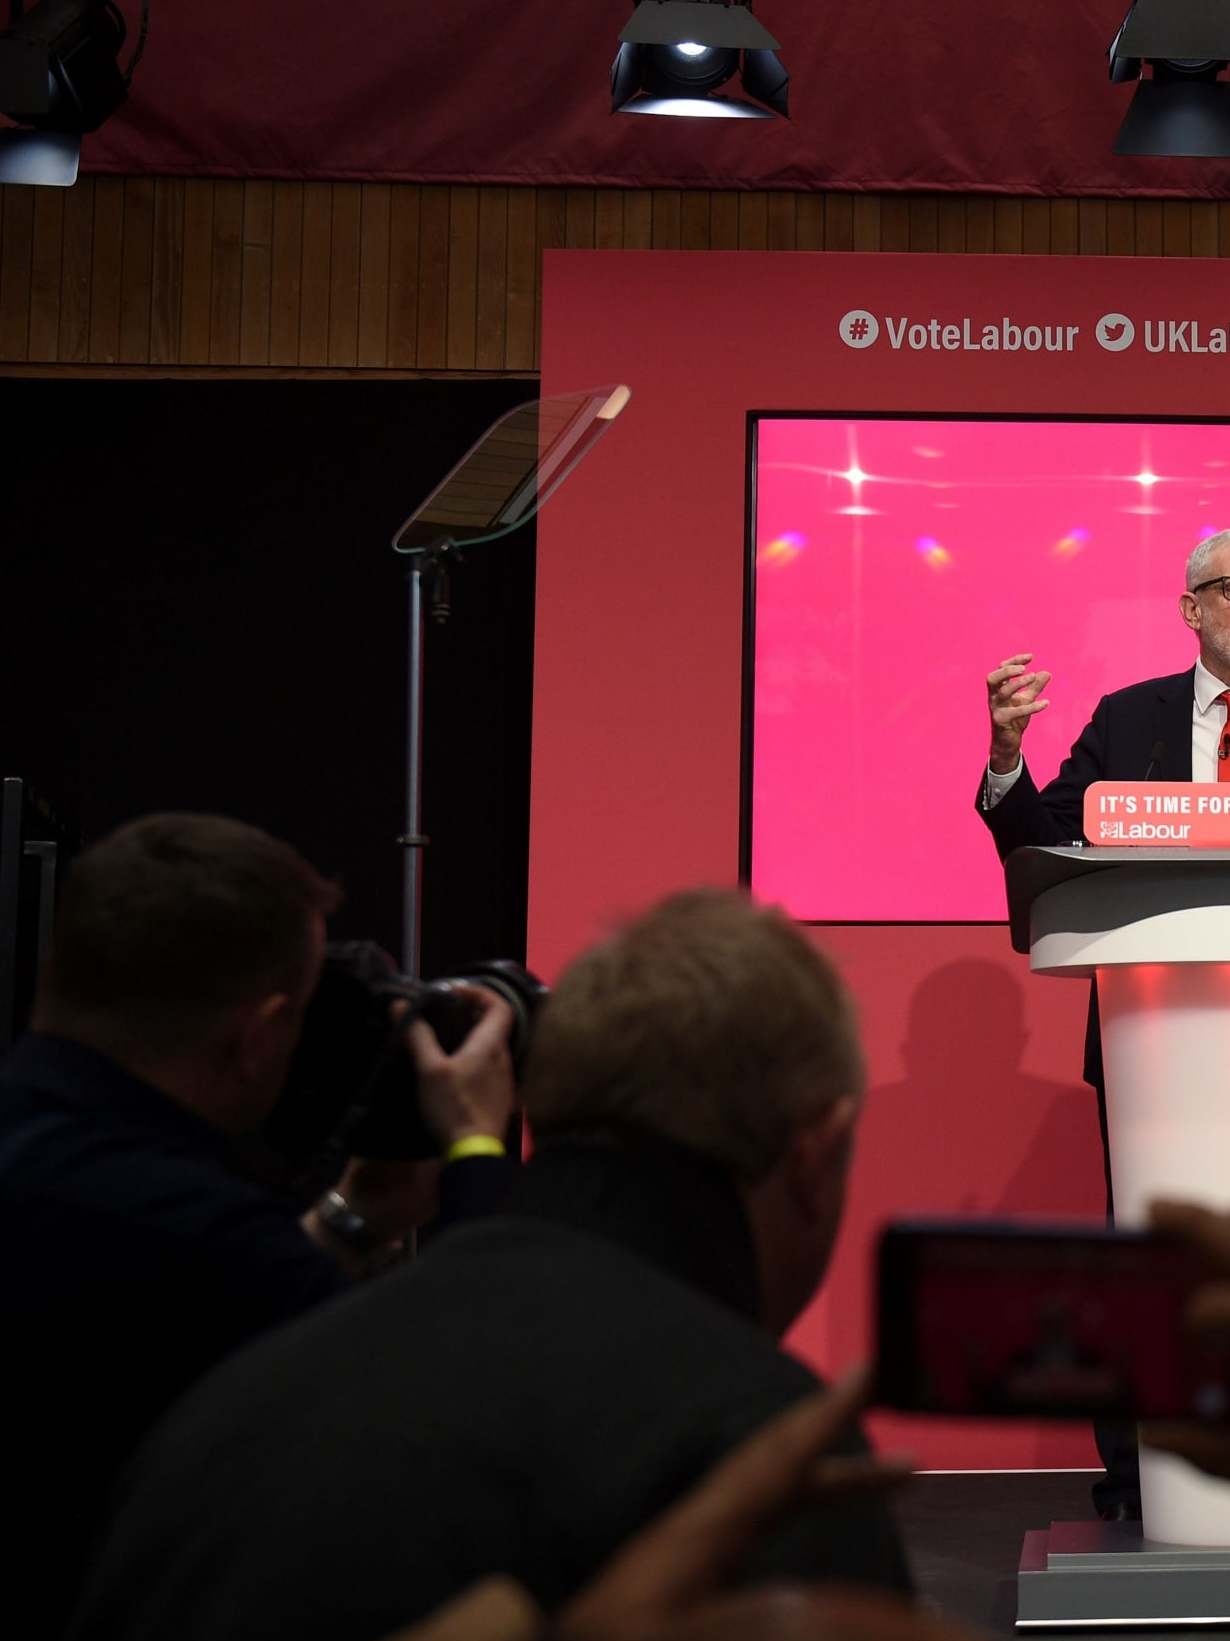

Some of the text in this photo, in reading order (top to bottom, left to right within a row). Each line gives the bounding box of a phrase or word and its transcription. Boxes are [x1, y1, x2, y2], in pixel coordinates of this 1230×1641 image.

[885, 317, 1079, 351] VoteLabour
[1100, 796, 1137, 814] IT'S
[1143, 796, 1191, 814] TIME
[1118, 821, 1191, 839] Labour
